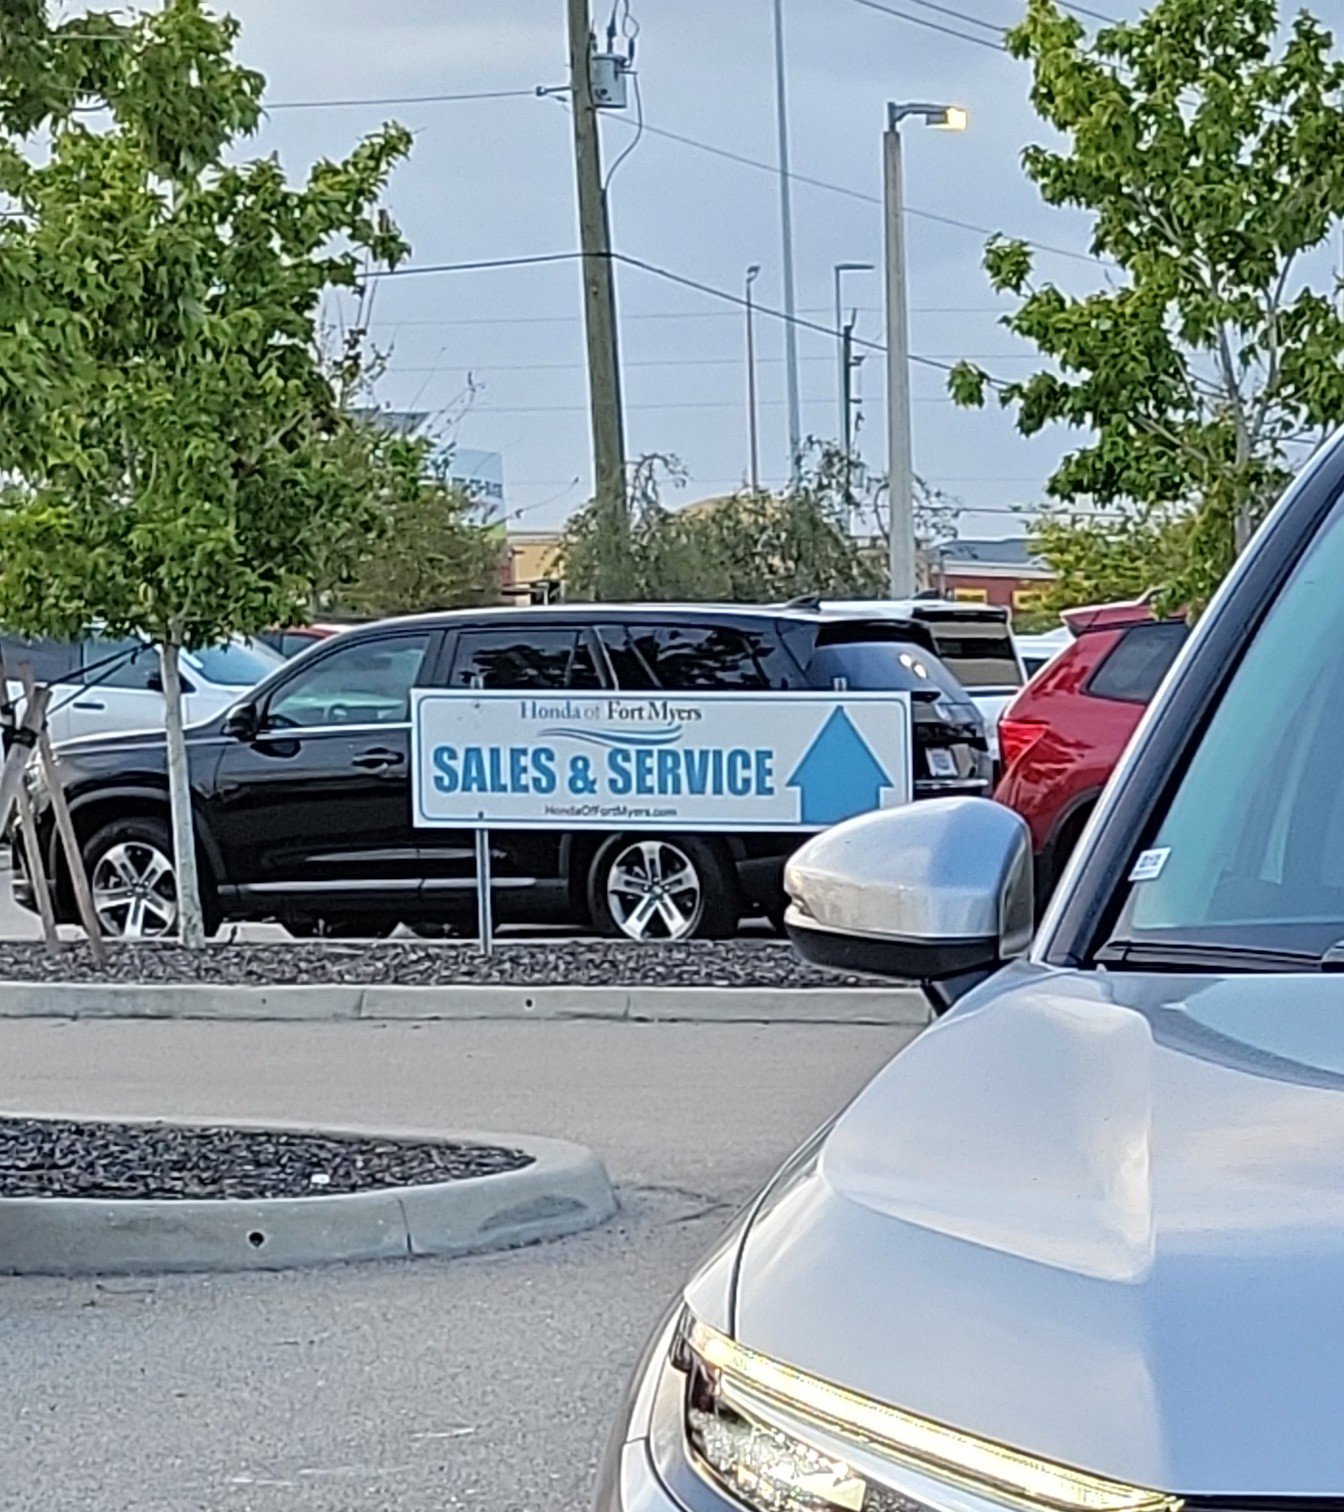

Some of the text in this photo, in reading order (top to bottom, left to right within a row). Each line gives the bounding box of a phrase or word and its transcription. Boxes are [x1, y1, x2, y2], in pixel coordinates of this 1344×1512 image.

[520, 700, 702, 726] Honda of Fort Myers
[433, 746, 775, 796] SALES & SERVICE
